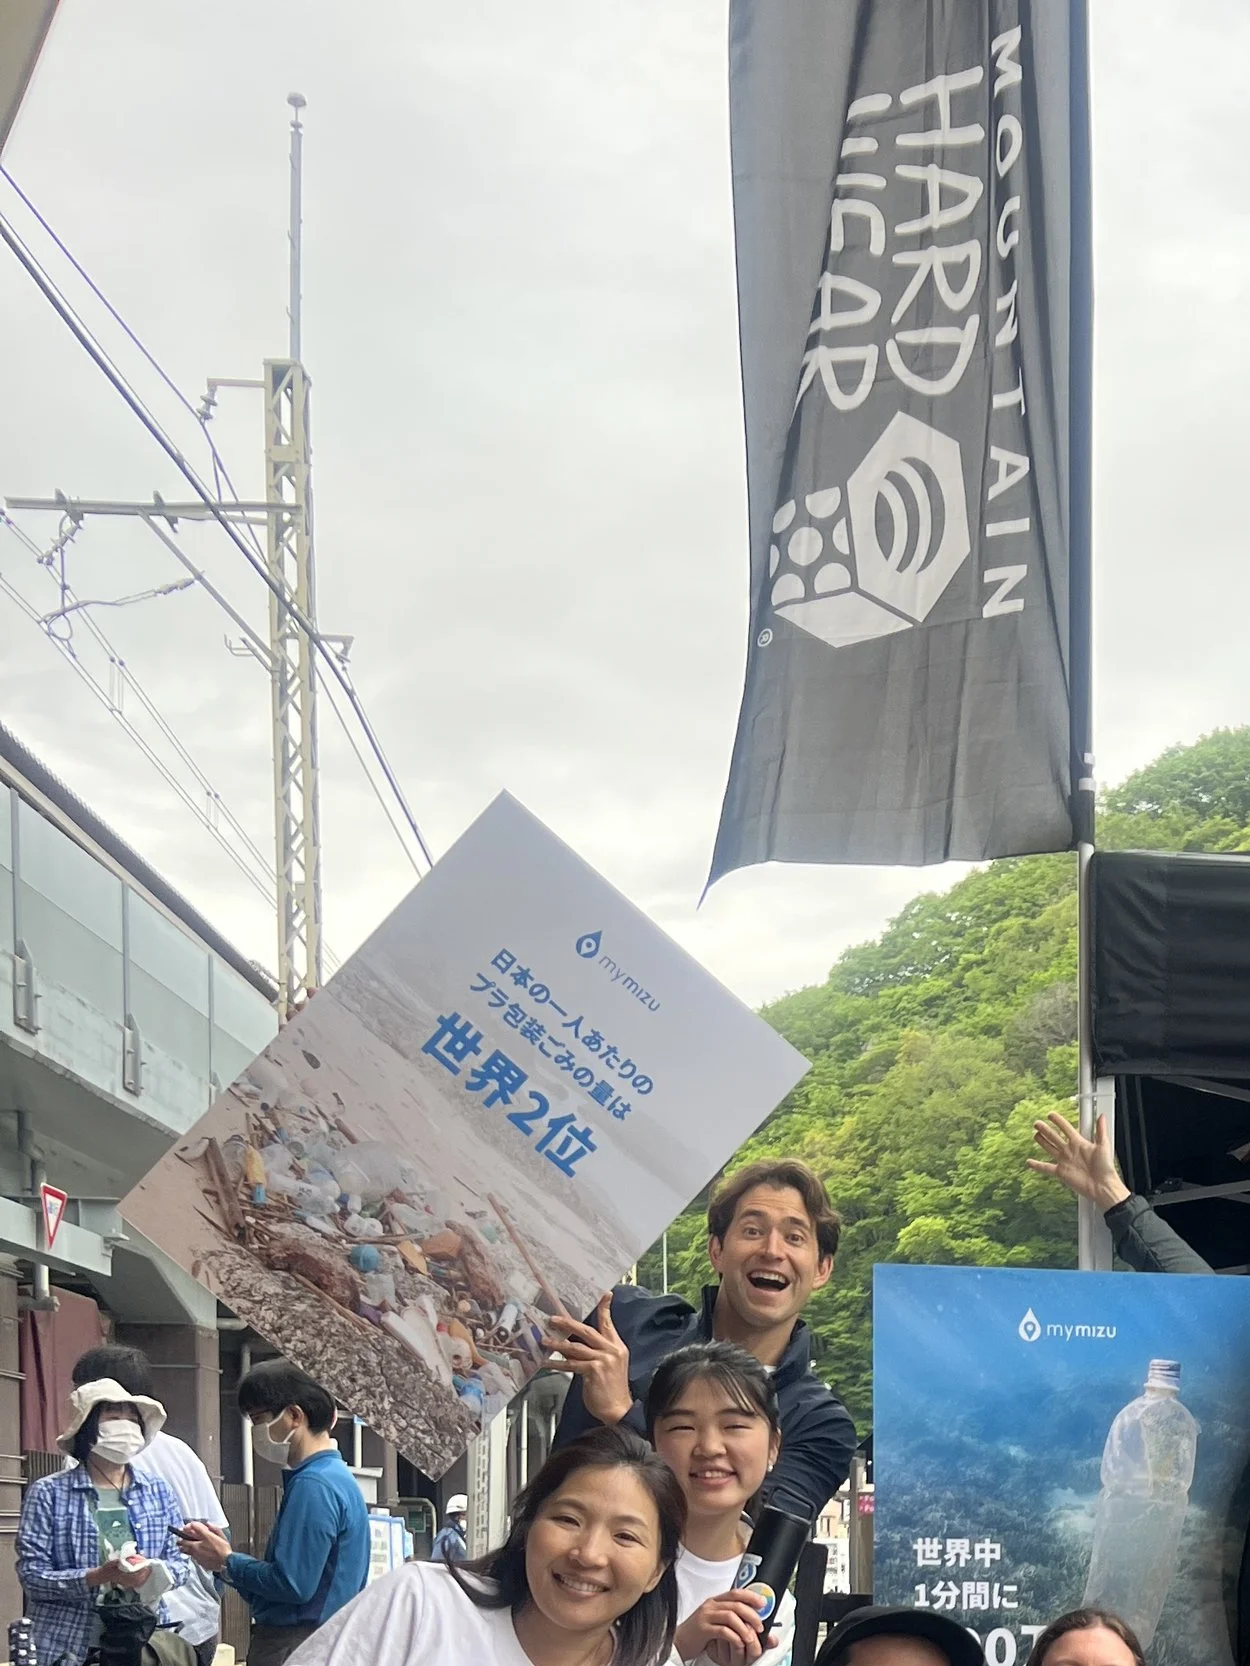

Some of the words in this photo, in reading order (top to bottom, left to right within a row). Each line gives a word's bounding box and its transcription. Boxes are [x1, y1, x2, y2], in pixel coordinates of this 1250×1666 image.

[886, 65, 985, 395] HARD
[982, 24, 1031, 618] MOUNTAIN
[469, 972, 633, 1121] プラ包装ごみの量は
[490, 948, 655, 1096] 日本の一人あたりの
[598, 955, 661, 1012] mymizu
[421, 1012, 598, 1178] 世界2位
[1046, 1324, 1117, 1342] mymizu
[912, 1537, 1002, 1568] 世界中
[914, 1580, 1019, 1610] 1分間に
